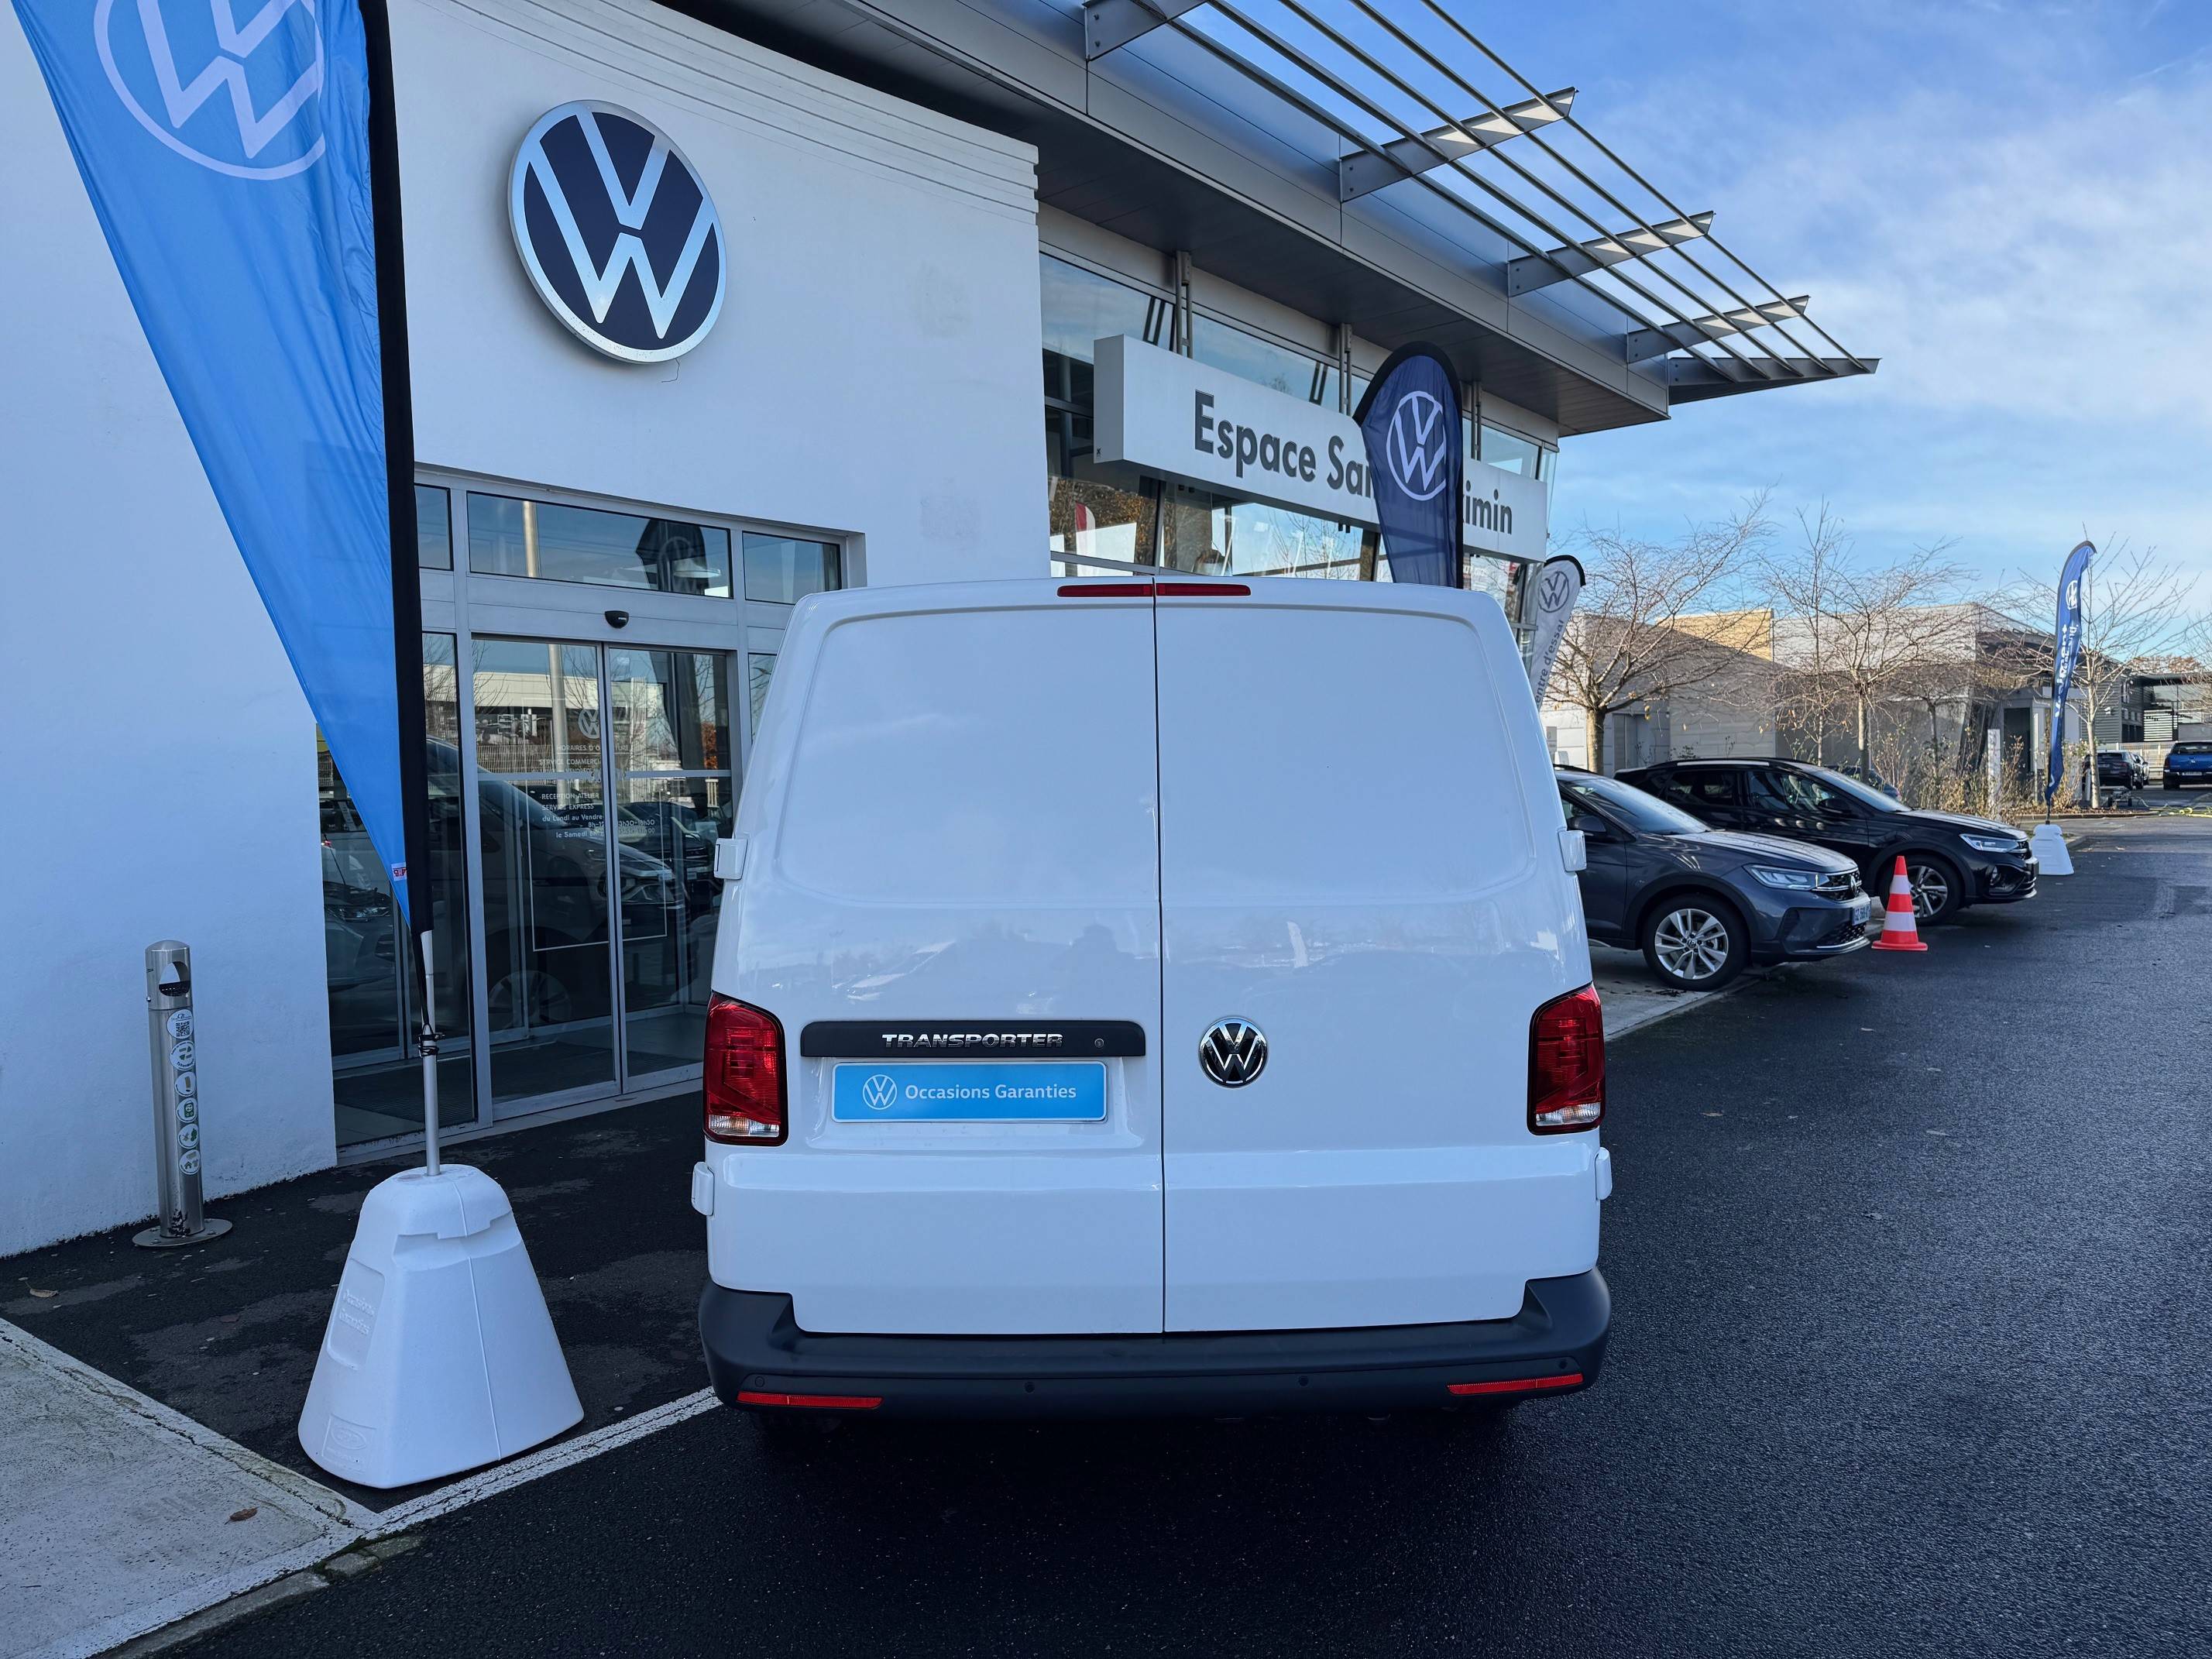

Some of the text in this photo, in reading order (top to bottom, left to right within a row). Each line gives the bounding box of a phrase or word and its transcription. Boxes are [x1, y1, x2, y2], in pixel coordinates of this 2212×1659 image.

[517, 104, 722, 349] VW
[1195, 390, 1317, 482] Espace
[1389, 392, 1447, 497] VW
[1538, 571, 1569, 613] VW
[1534, 668, 1548, 707] entre
[881, 1033, 1064, 1049] TRANSPORTER
[1200, 1018, 1268, 1088] VW
[863, 1074, 1077, 1110] VW Occasions Garanties
